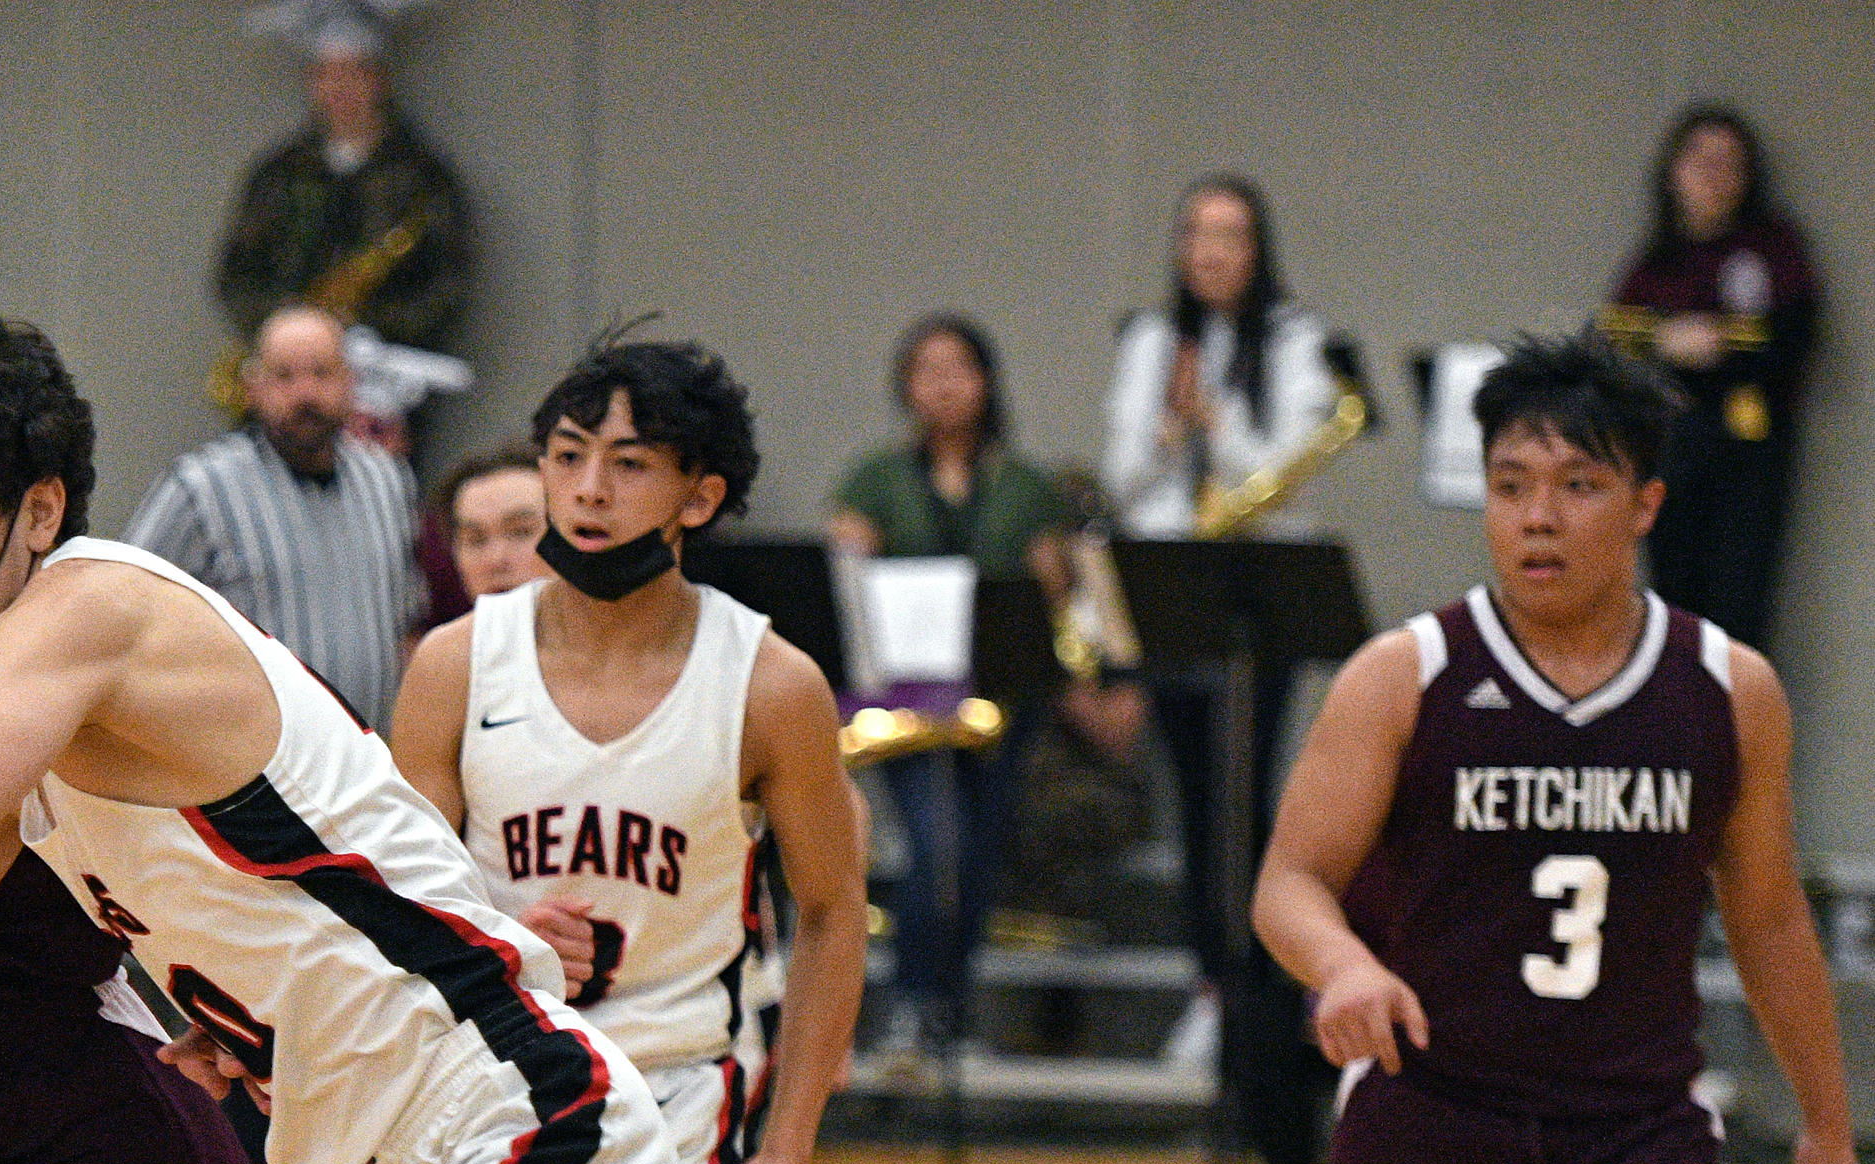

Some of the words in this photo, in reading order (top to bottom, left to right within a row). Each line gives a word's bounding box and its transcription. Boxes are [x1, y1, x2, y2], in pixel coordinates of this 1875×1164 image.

[1453, 766, 1693, 834] KETCHIKAN
[501, 804, 689, 898] BEARS
[1521, 854, 1610, 1001] 3
